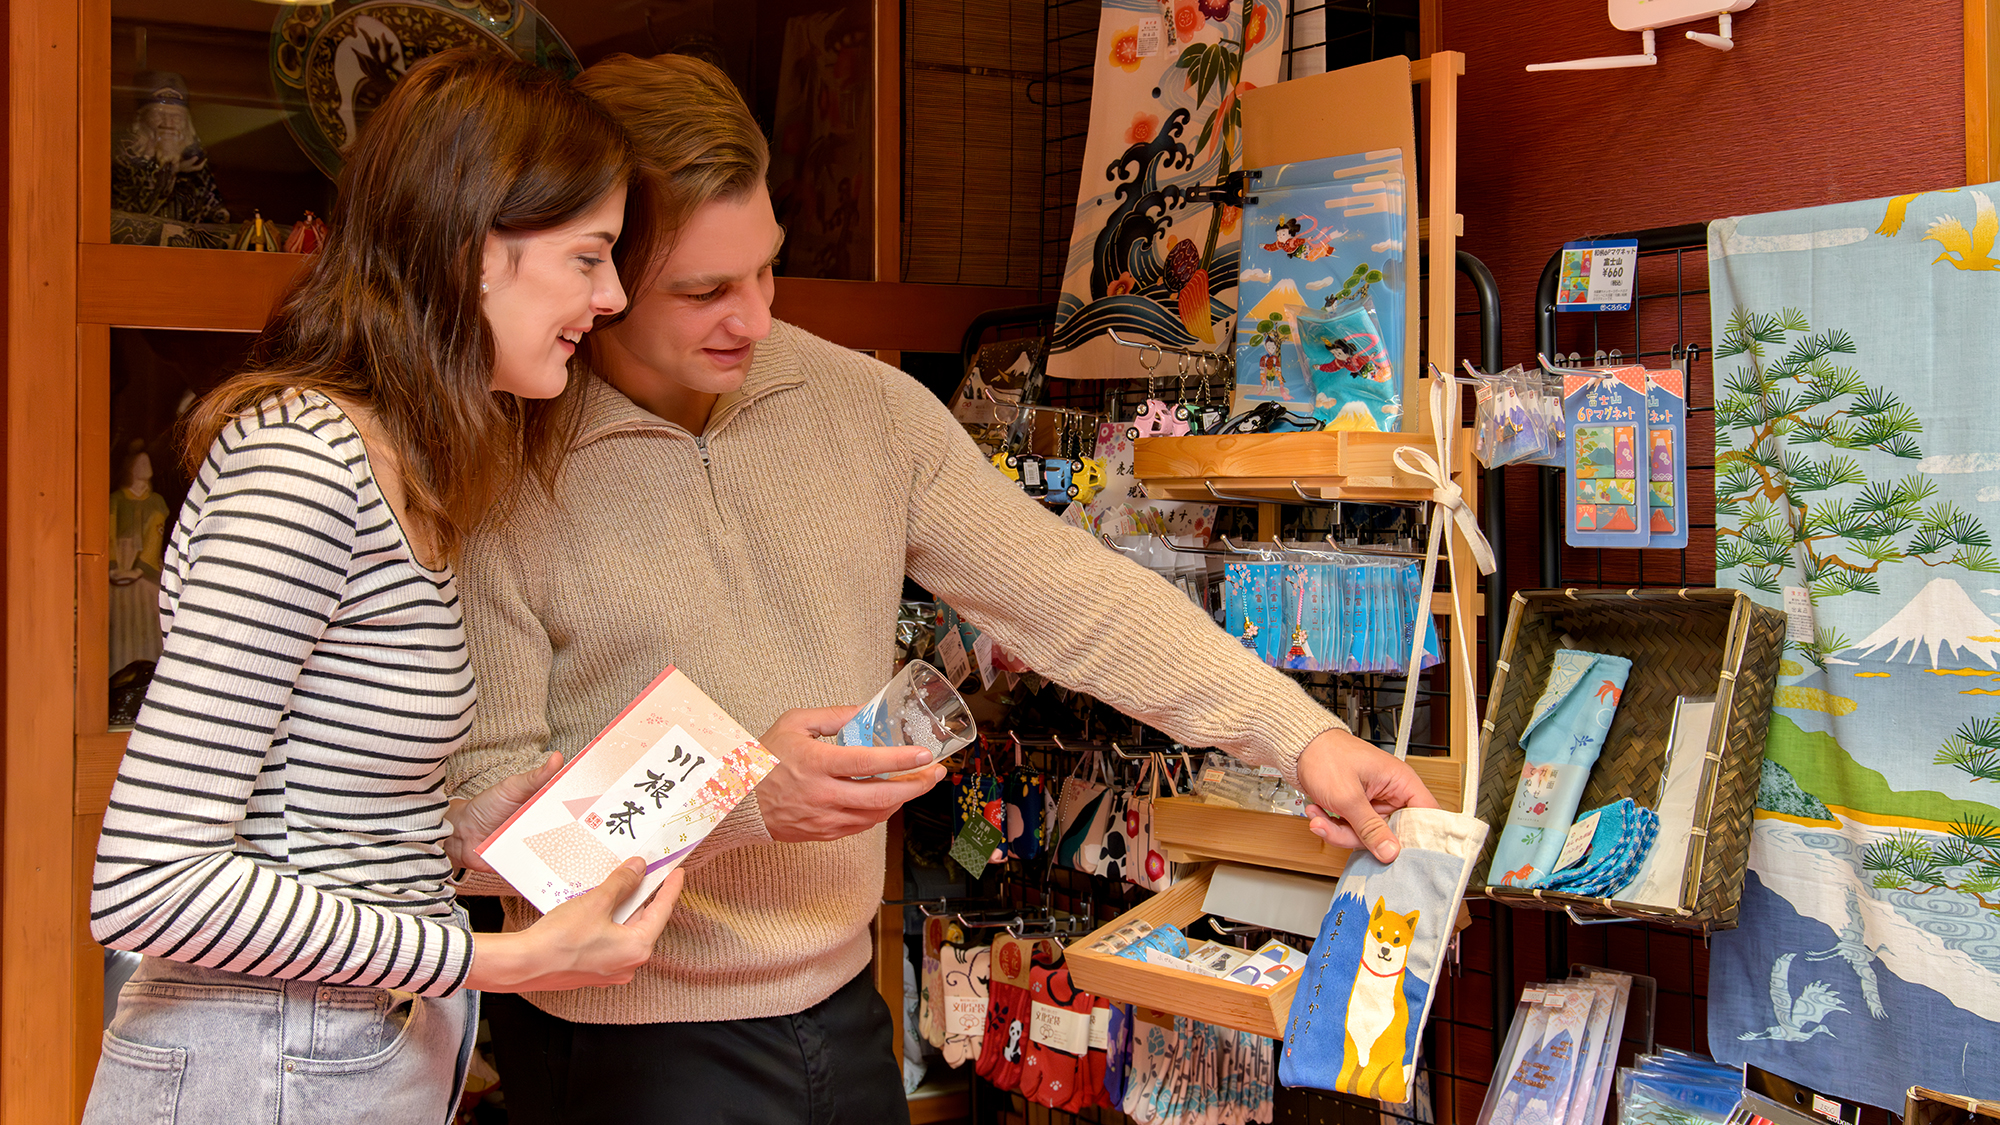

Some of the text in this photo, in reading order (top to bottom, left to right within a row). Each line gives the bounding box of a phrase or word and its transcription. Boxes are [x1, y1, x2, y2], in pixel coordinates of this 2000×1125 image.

[1603, 258, 1623, 267] 富士山
[1602, 267, 1624, 277] ¥660
[1586, 391, 1622, 407] 富士山
[1577, 405, 1636, 422] 6Pマグネット
[1647, 409, 1673, 423] ネット
[605, 744, 705, 839] 川根茶
[1517, 767, 1537, 808] てぬぐい
[1533, 768, 1549, 799] ガーゼ
[1304, 909, 1346, 1034] 富士山ですか?
[952, 1002, 986, 1014] 文化足袋
[1035, 1010, 1061, 1026] 文化足袋
